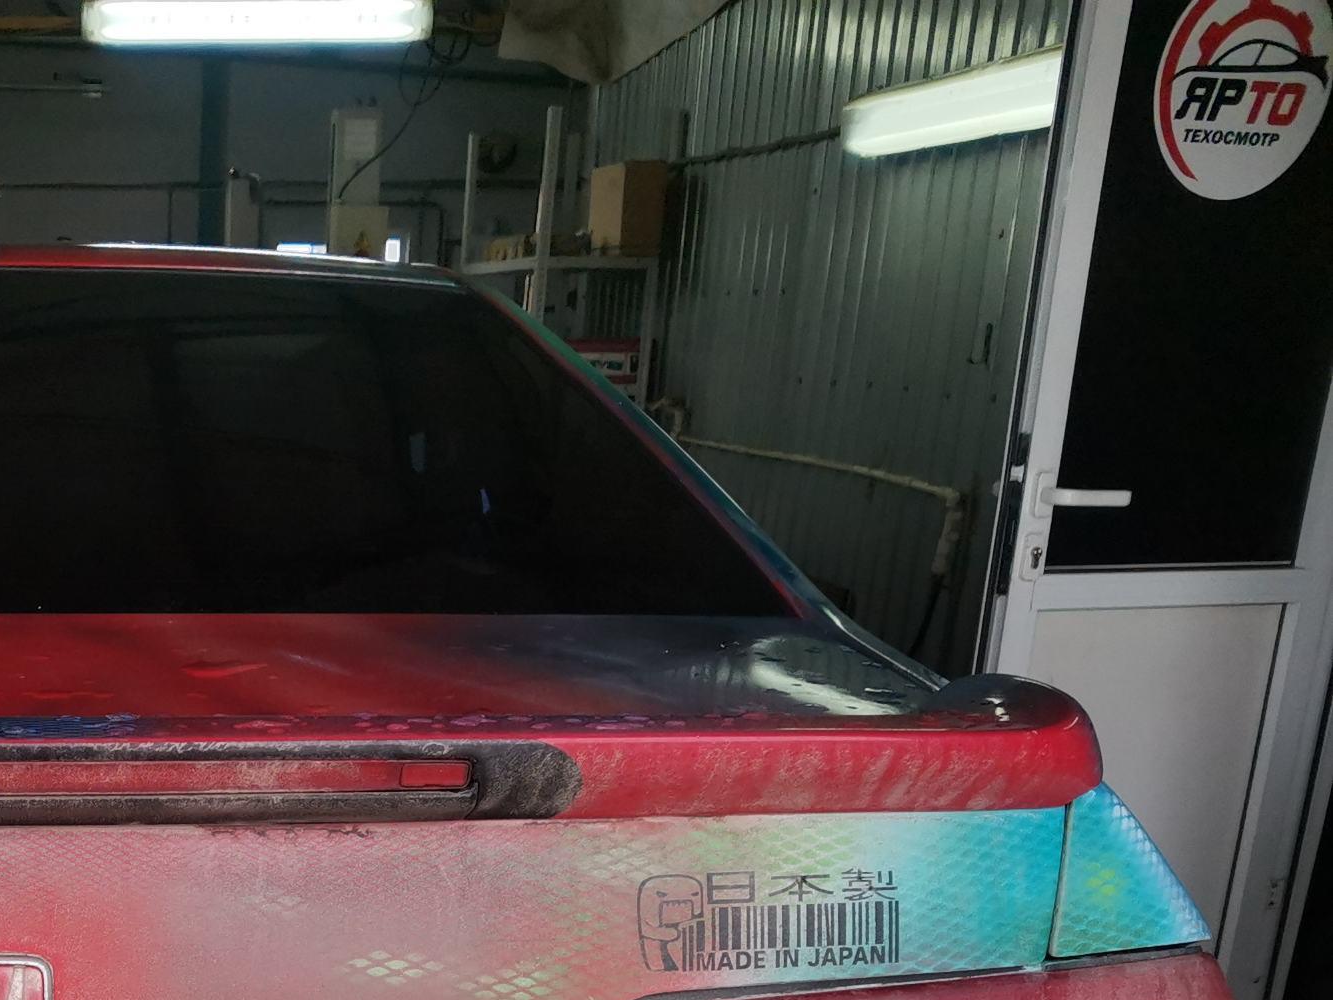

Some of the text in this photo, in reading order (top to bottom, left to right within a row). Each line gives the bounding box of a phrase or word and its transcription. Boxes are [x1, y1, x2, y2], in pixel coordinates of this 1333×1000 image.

[1174, 76, 1307, 126] ЯРТО
[1183, 128, 1280, 147] ТЕХОСМОТР
[707, 868, 899, 905] 日本製
[696, 945, 887, 972] MADE IN JAPAN
